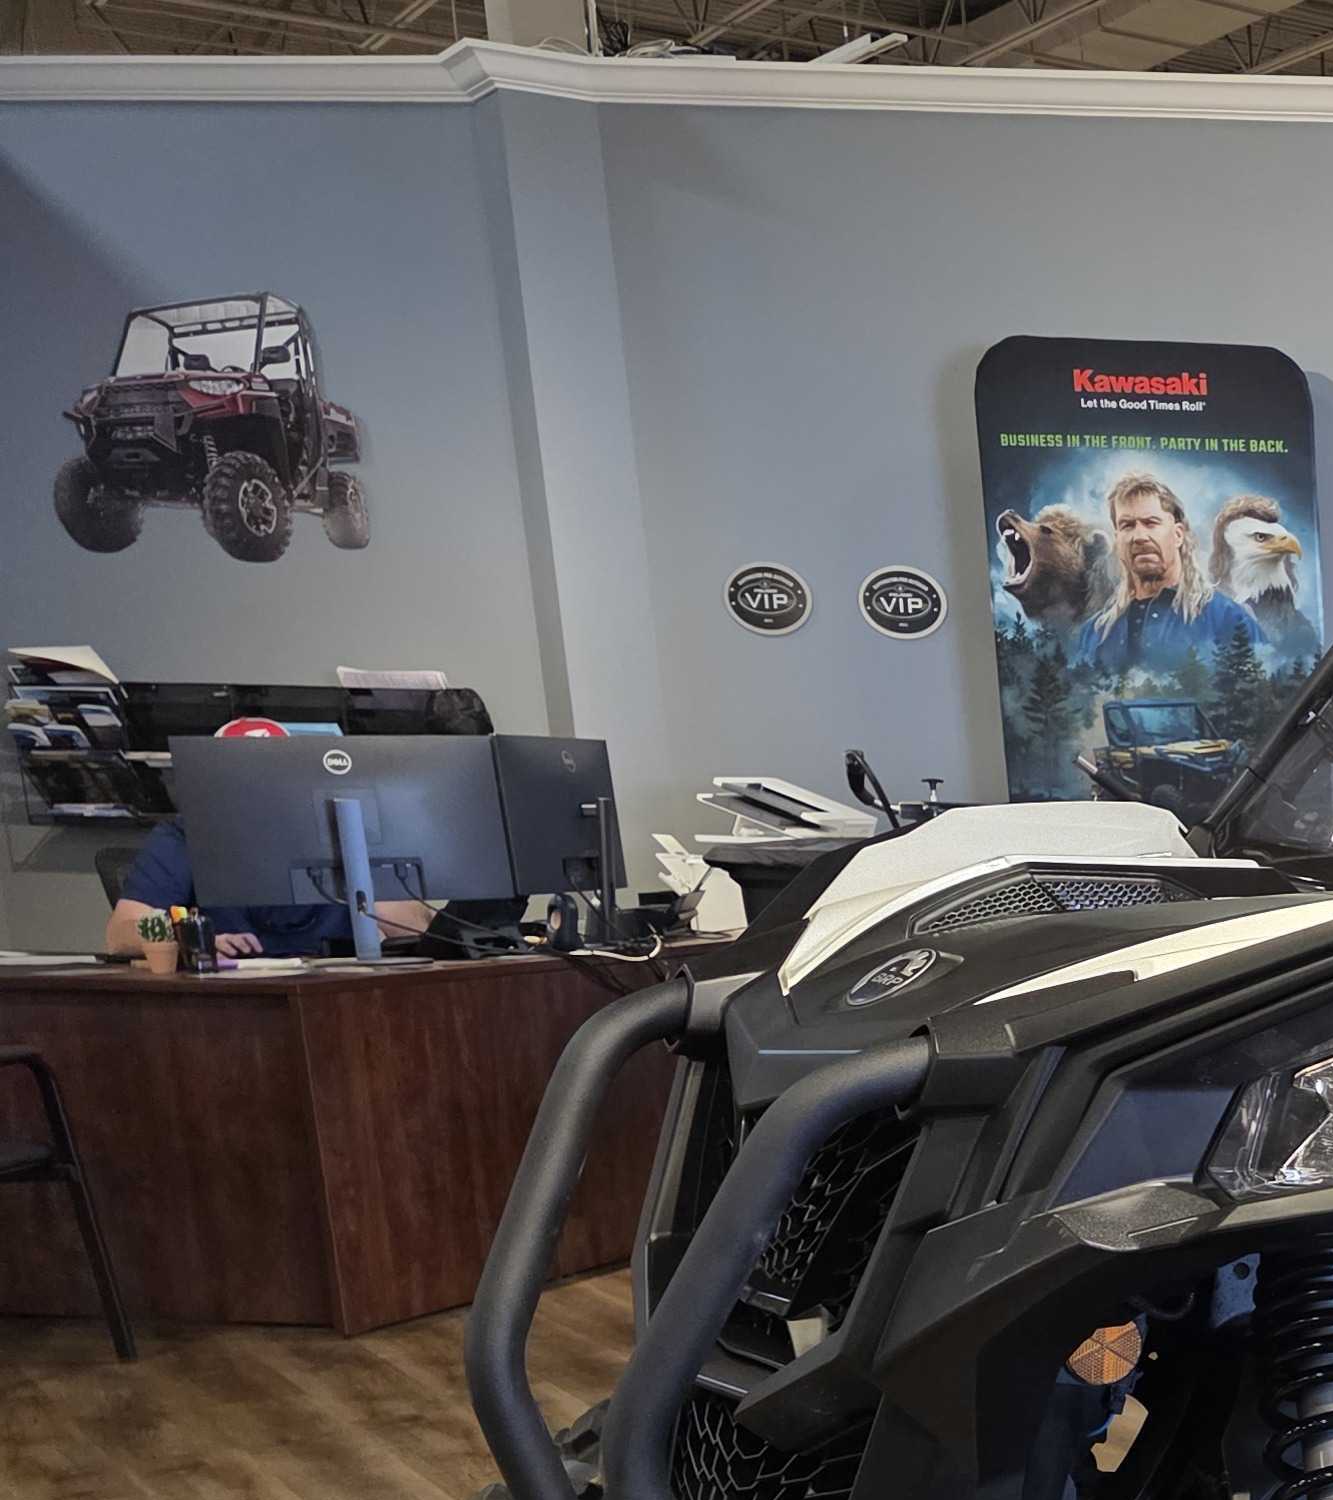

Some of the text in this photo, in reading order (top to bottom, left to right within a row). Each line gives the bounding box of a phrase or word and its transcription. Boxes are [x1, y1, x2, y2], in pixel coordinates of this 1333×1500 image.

[1072, 368, 1208, 395] Kawasaki
[1080, 398, 1099, 409] Let
[1100, 399, 1117, 409] the
[1119, 399, 1147, 410] Good
[1149, 400, 1180, 411] Times
[1000, 433, 1289, 453] BUSINESS IN THE FRONT. PARTY IN THE BACK.
[744, 592, 788, 610] VIP
[879, 596, 923, 614] VIP
